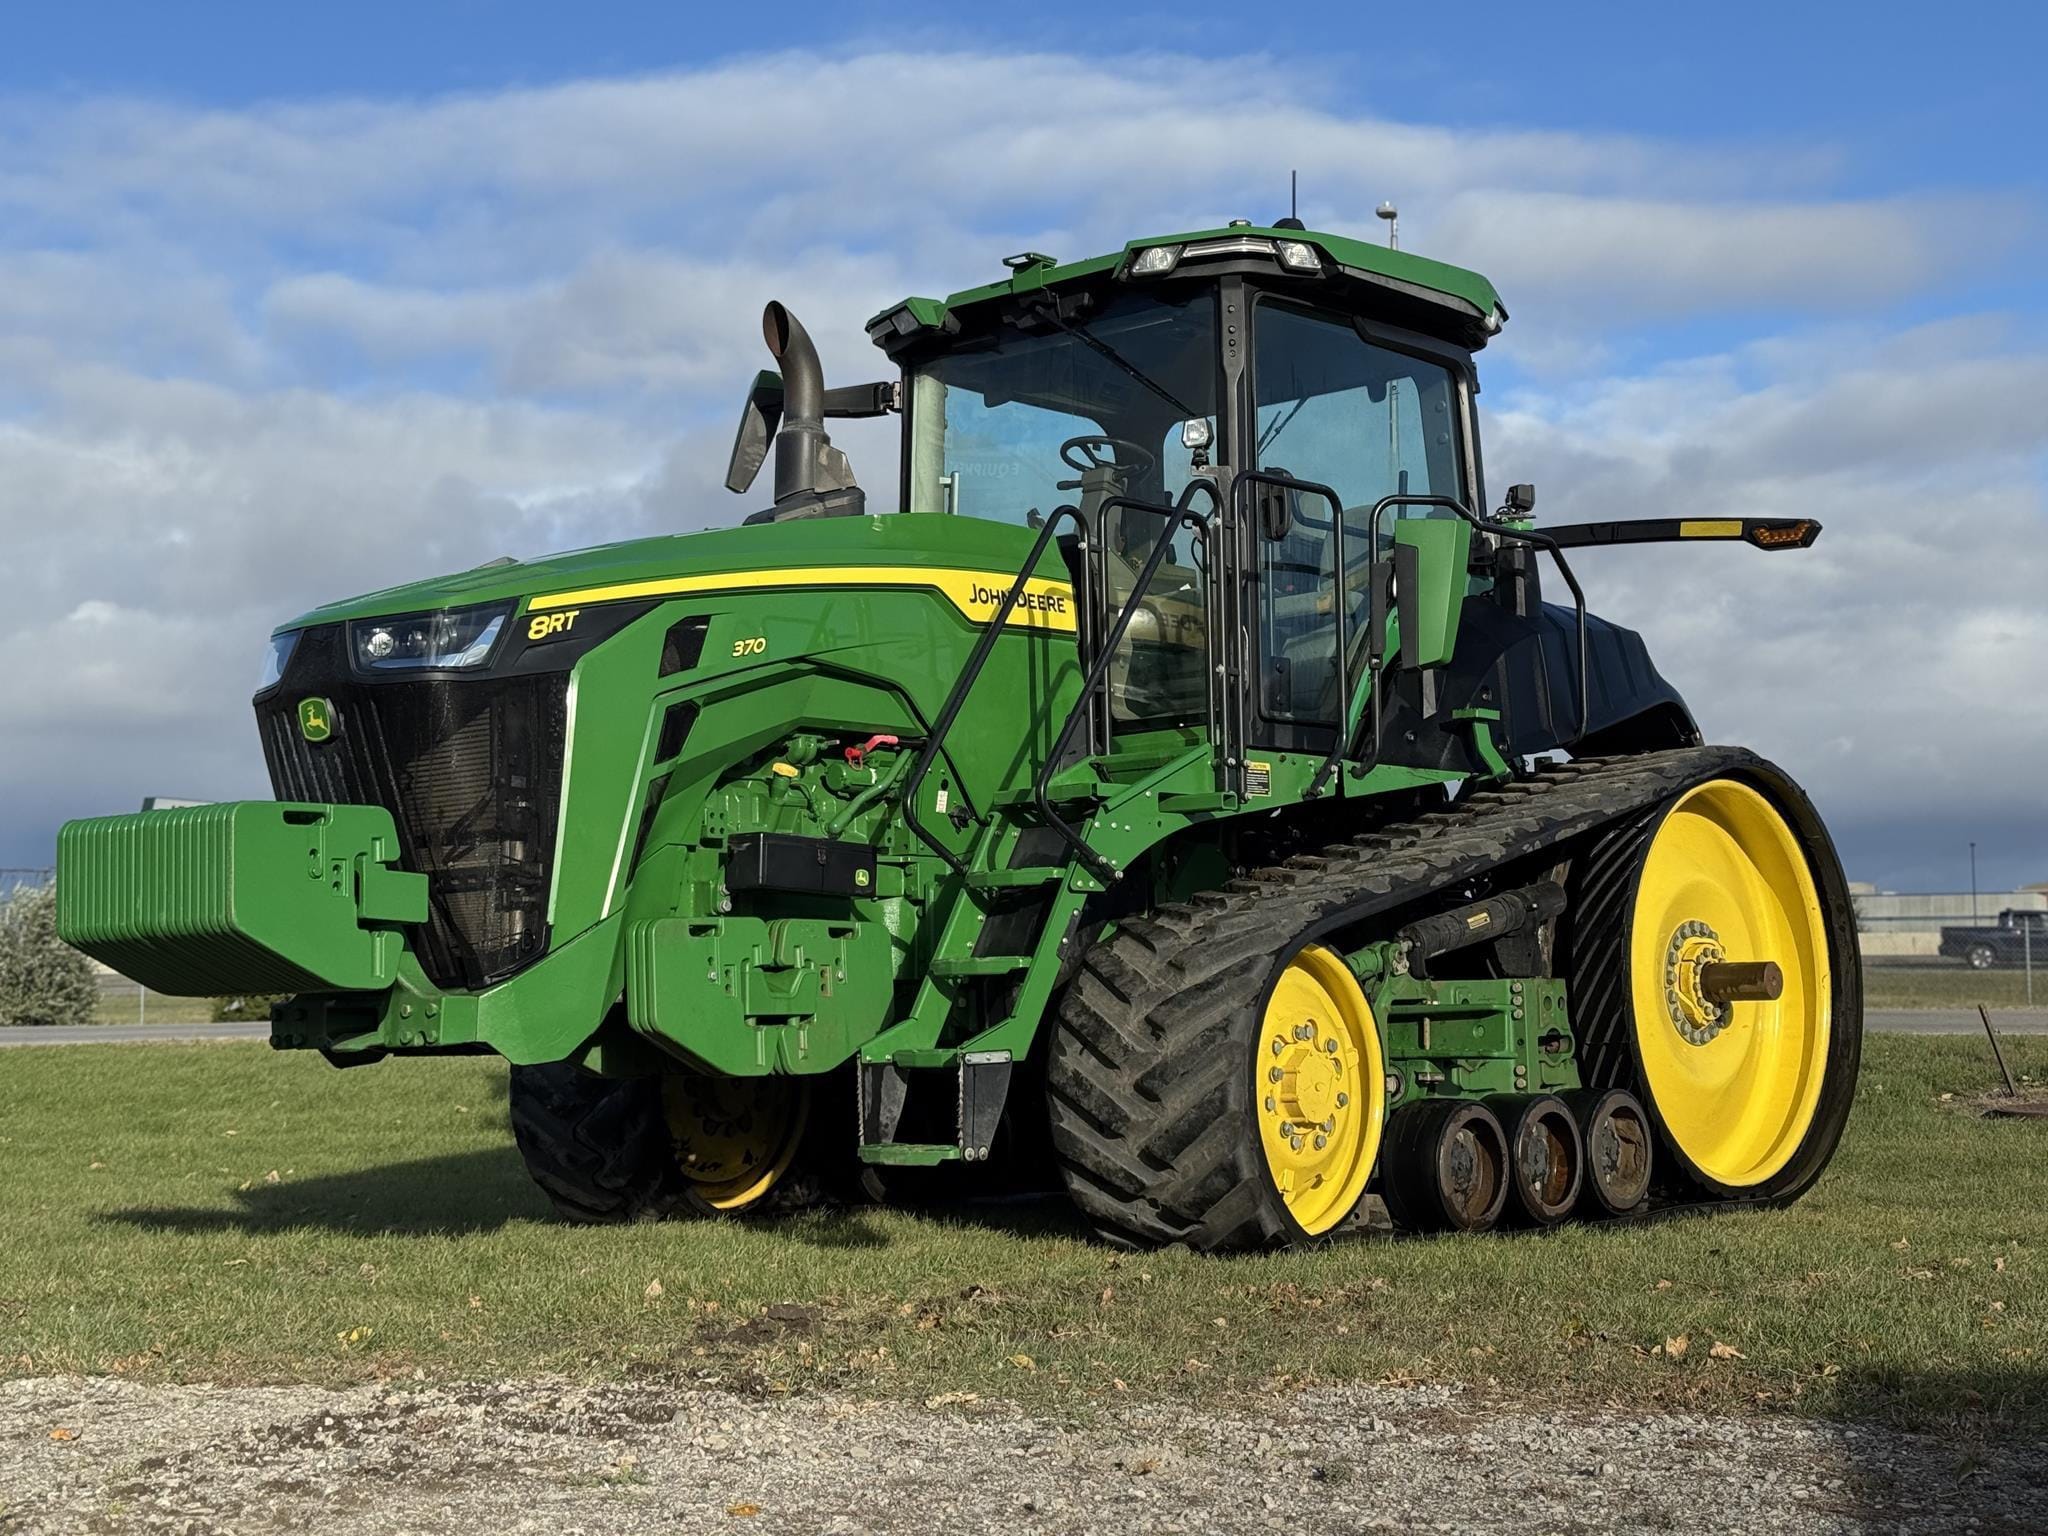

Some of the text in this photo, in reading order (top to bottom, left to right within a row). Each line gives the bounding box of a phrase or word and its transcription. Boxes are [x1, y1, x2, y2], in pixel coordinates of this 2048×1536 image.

[1016, 589, 1067, 613] DEERE
[528, 610, 580, 640] 8RT
[732, 637, 767, 657] 370
